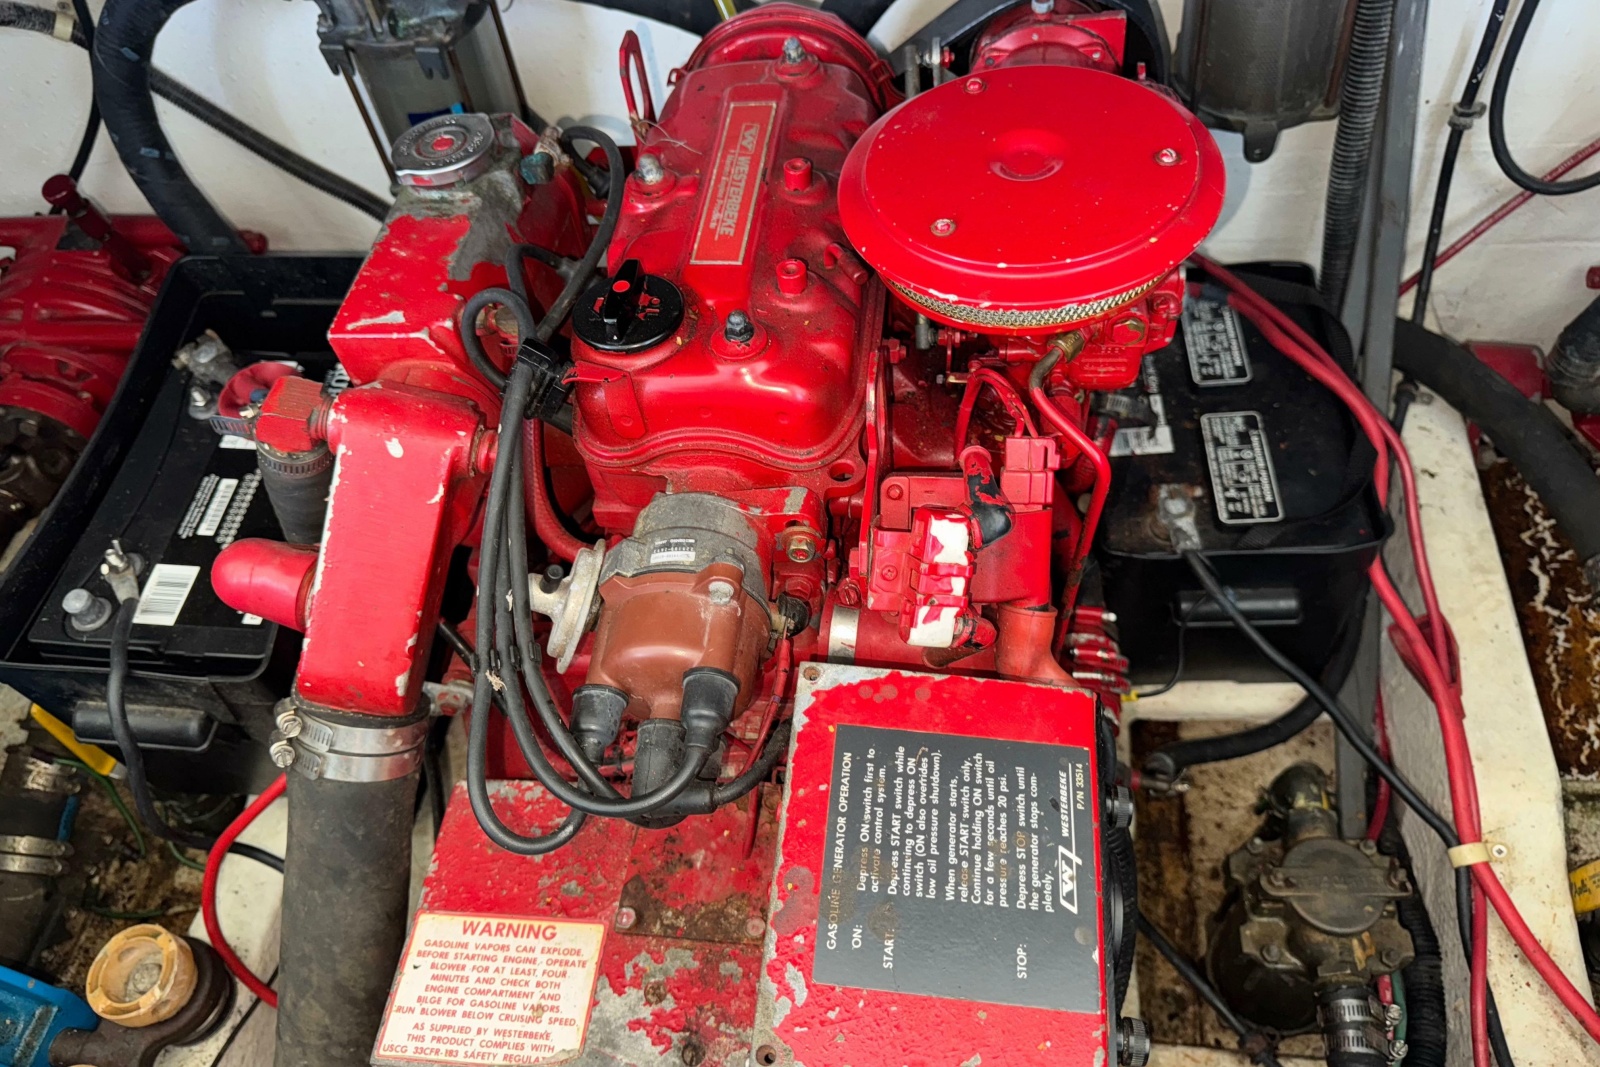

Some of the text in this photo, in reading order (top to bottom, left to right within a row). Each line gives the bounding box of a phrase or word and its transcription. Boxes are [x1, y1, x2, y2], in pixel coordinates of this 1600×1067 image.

[720, 156, 751, 236] WESTERBEKE
[985, 761, 995, 773] oil
[1076, 764, 1084, 809] P/N 33514
[985, 778, 995, 800] until
[1059, 771, 1069, 837] WESTERBEKE
[870, 765, 887, 892] activate control system.
[902, 758, 917, 896] continuing to depress ON
[914, 757, 928, 897] switch (ON also overrides
[926, 750, 941, 898] low oil pressure shutdown).
[946, 812, 958, 864] generator
[959, 757, 972, 902] release START switch only.
[972, 753, 984, 904] Continue holding ON switch
[986, 805, 995, 846] seconds
[998, 774, 1010, 907] pressure reaches 20 psi.
[1029, 773, 1041, 910] the generator stops com-
[827, 752, 852, 950] GASOLINE GENERATOR OPERATION
[852, 749, 875, 948] ON: Depress ON switch first to
[883, 746, 905, 969] START: Depress START switch while
[985, 851, 995, 872] few
[946, 869, 957, 901] When
[1016, 767, 1028, 978] STOP: Depress STOP switch until
[1043, 871, 1055, 912] pletely.
[985, 889, 995, 905] for
[424, 939, 584, 956] GASOLINE VAPORS CAN EXPLODE.
[462, 920, 557, 940] WARNING
[417, 950, 449, 960] BEFORE
[454, 952, 498, 963] STARTING
[546, 958, 587, 968] OPERATE
[430, 962, 466, 971] BLOWER
[472, 965, 489, 973] FOR
[425, 984, 561, 1001] ENGINE COMPARTMENT AND
[430, 974, 561, 989] MINUTES AND CHECK BOTH
[396, 1006, 415, 1014] RUN
[420, 1008, 457, 1017] BLOWER
[462, 1010, 493, 1019] BELOW
[499, 1013, 542, 1024] CRUISING
[416, 995, 563, 1013] BILGE FOR GASOLINE VAPORS.
[407, 1034, 555, 1053] THIS PRODUCT COMPLIES WITH
[413, 1023, 425, 1031] AS
[430, 1024, 472, 1034] SUPPLIED
[476, 1027, 489, 1036] BY
[383, 1044, 408, 1053] USCG
[464, 1051, 498, 1060] SAFETY
